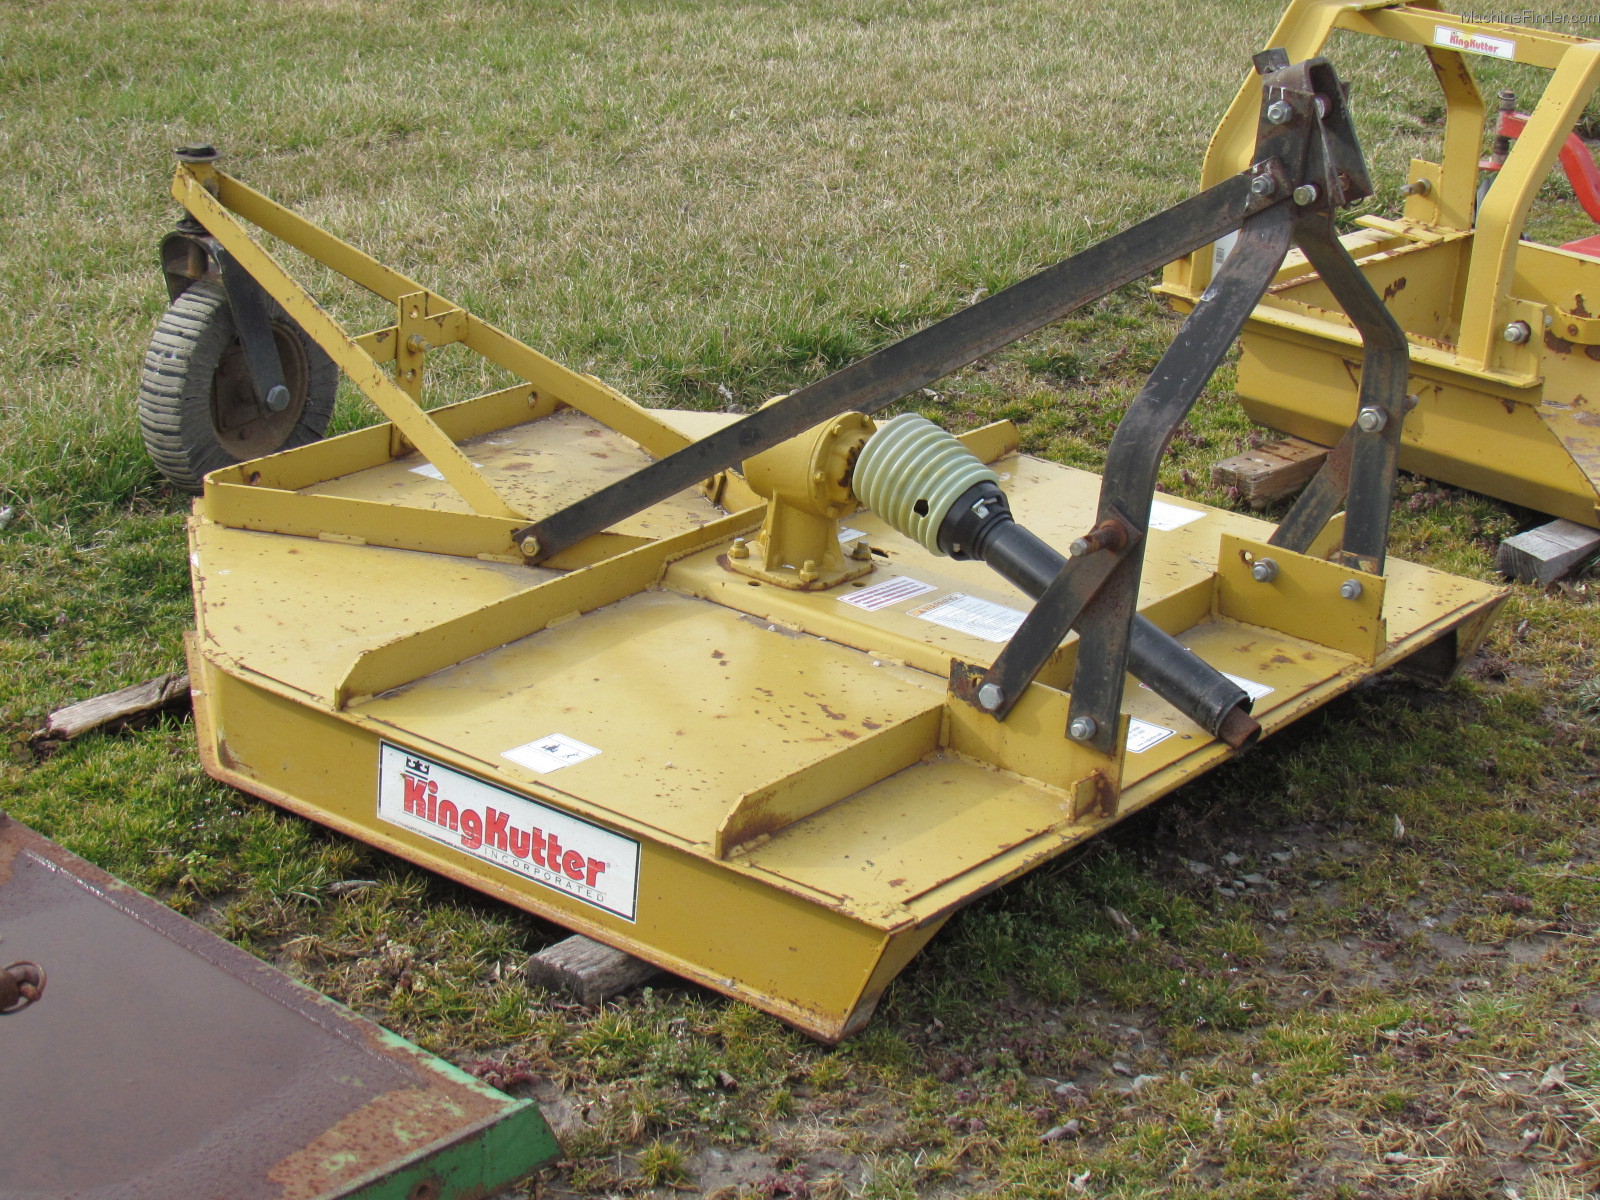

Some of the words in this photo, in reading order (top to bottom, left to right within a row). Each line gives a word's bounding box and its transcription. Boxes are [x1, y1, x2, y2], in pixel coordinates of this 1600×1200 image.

[1449, 34, 1499, 52] KingKutter
[403, 775, 605, 888] KingKutter
[484, 847, 604, 902] INCORPORATED
